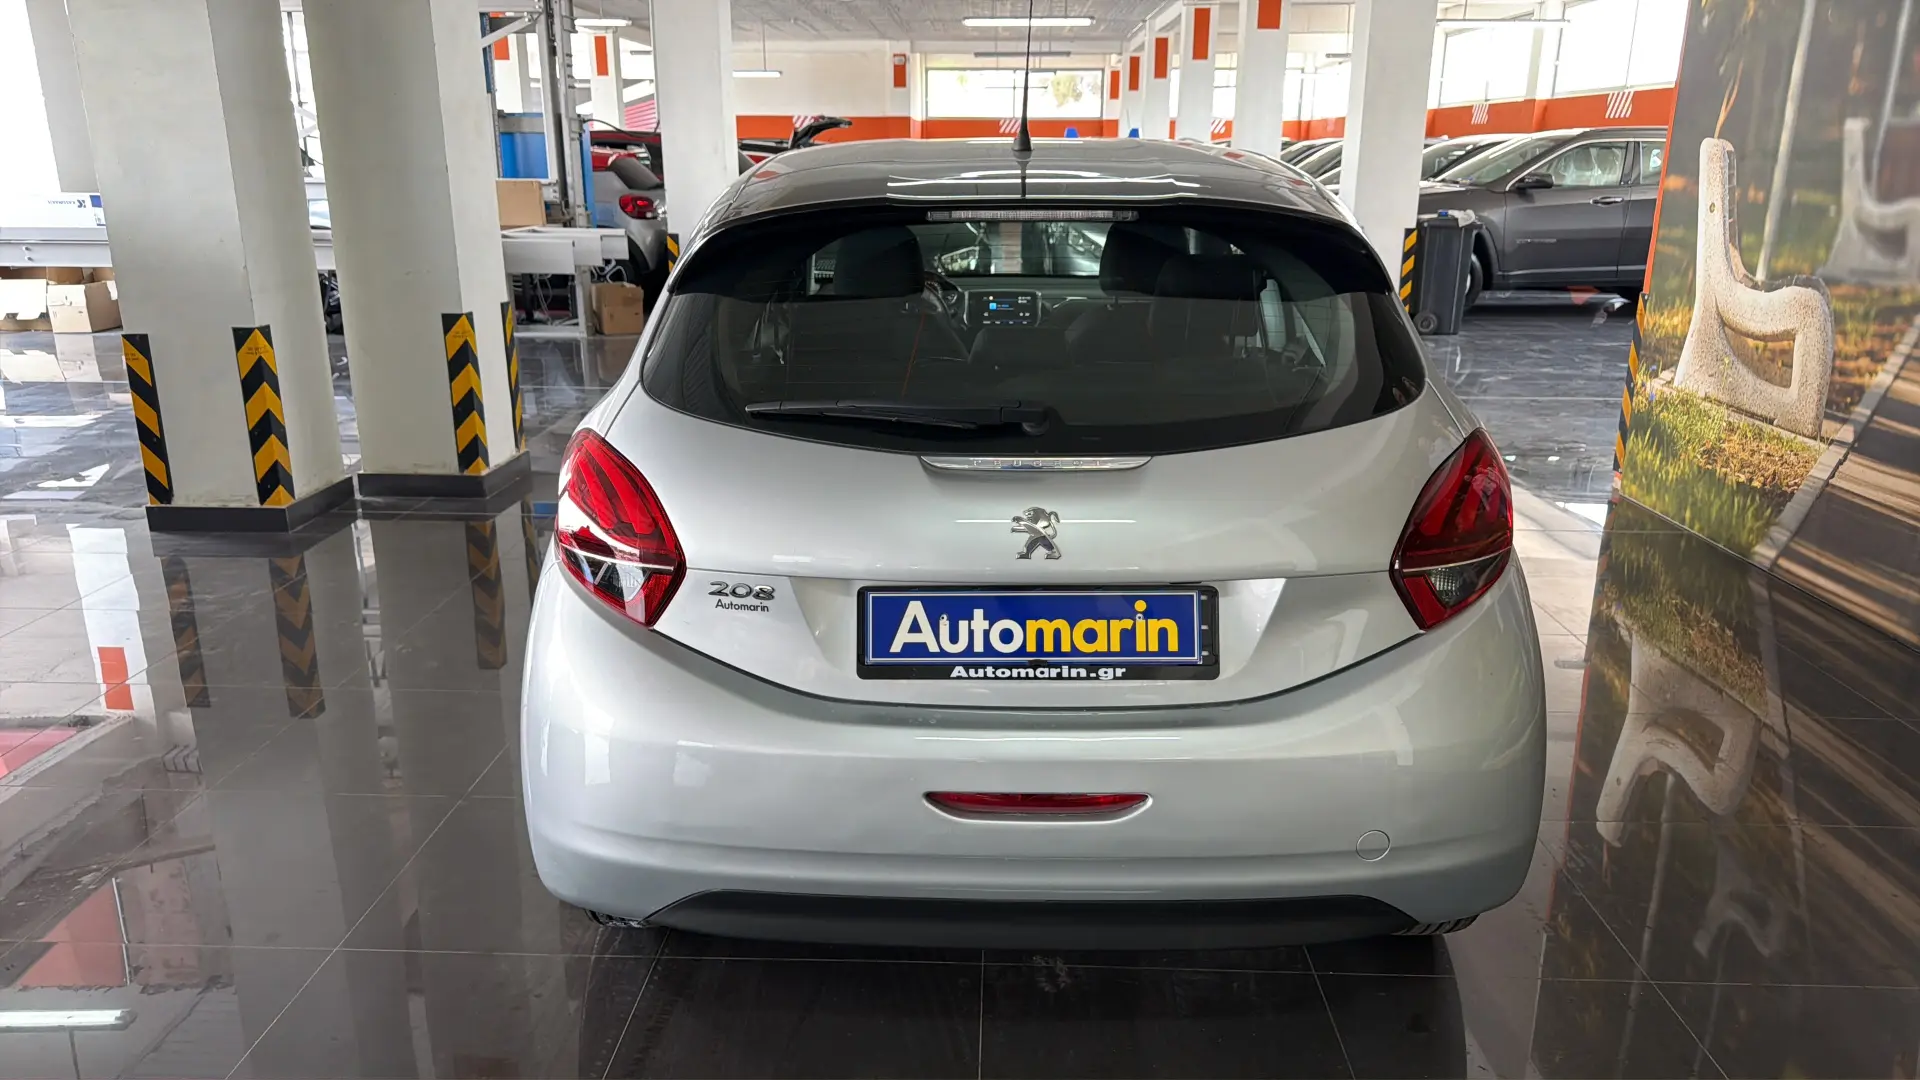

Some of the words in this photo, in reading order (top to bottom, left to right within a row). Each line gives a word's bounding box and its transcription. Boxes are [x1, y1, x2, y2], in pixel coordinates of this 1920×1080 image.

[708, 581, 775, 601] 208
[715, 598, 769, 612] Automarin
[889, 599, 1179, 653] Automarin
[950, 665, 1127, 679] Automarin.gr
